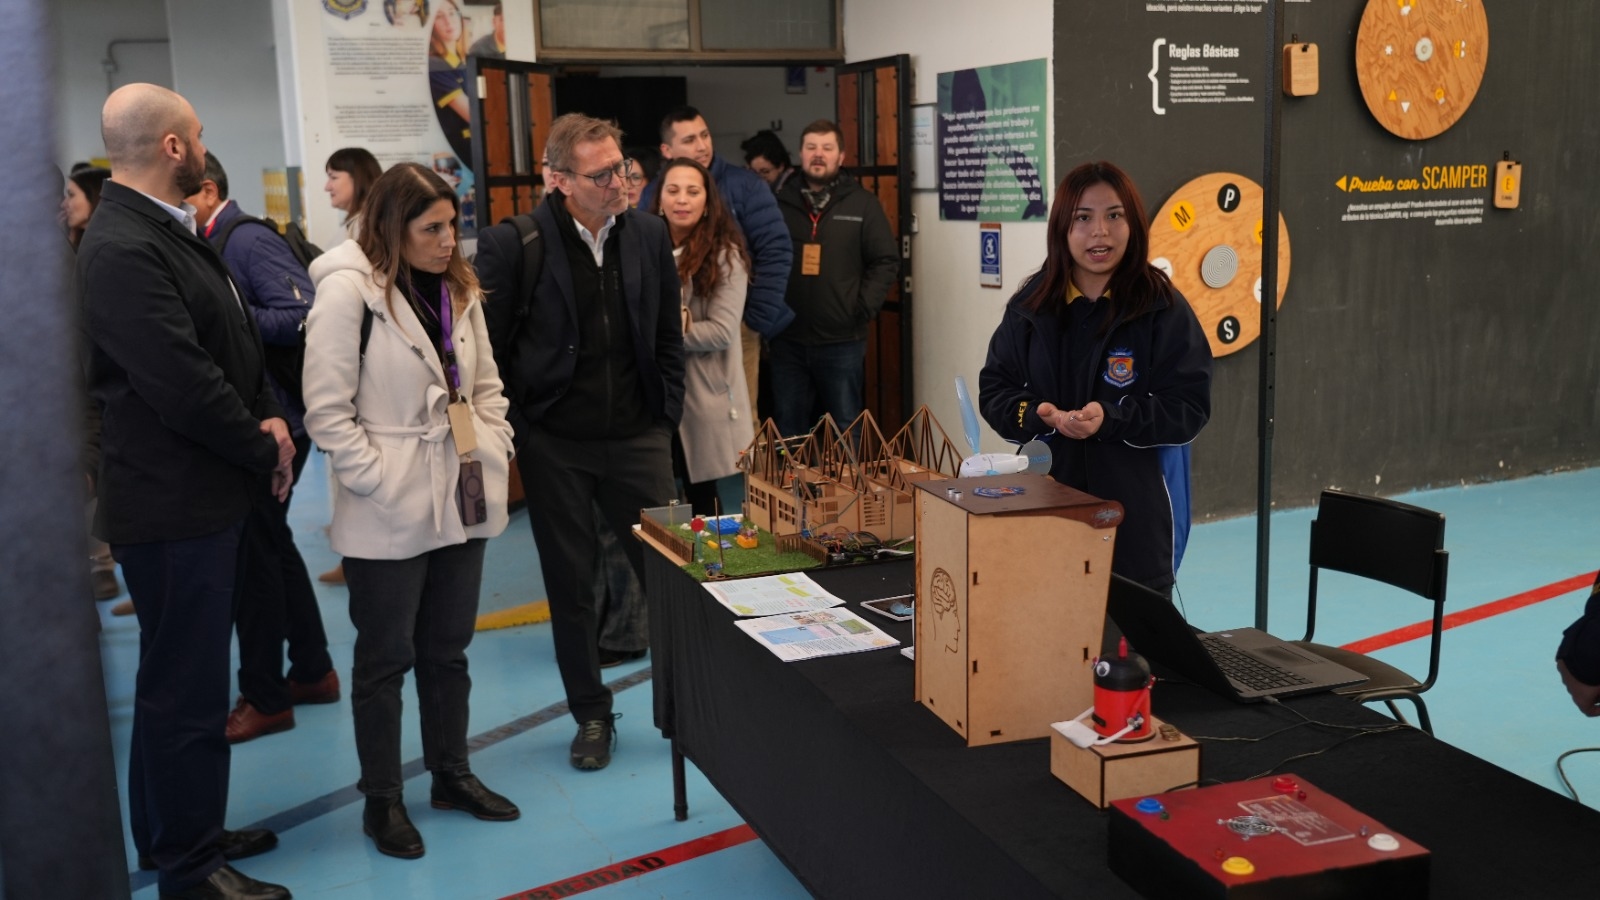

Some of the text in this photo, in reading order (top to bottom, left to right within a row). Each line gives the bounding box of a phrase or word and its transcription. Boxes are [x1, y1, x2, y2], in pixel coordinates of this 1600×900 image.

[1169, 44, 1239, 60] Reglas Básicas
[1348, 164, 1488, 192] Prueba con SCAMPER
[1224, 188, 1236, 208] P
[1174, 205, 1192, 228] M
[1223, 320, 1234, 340] S
